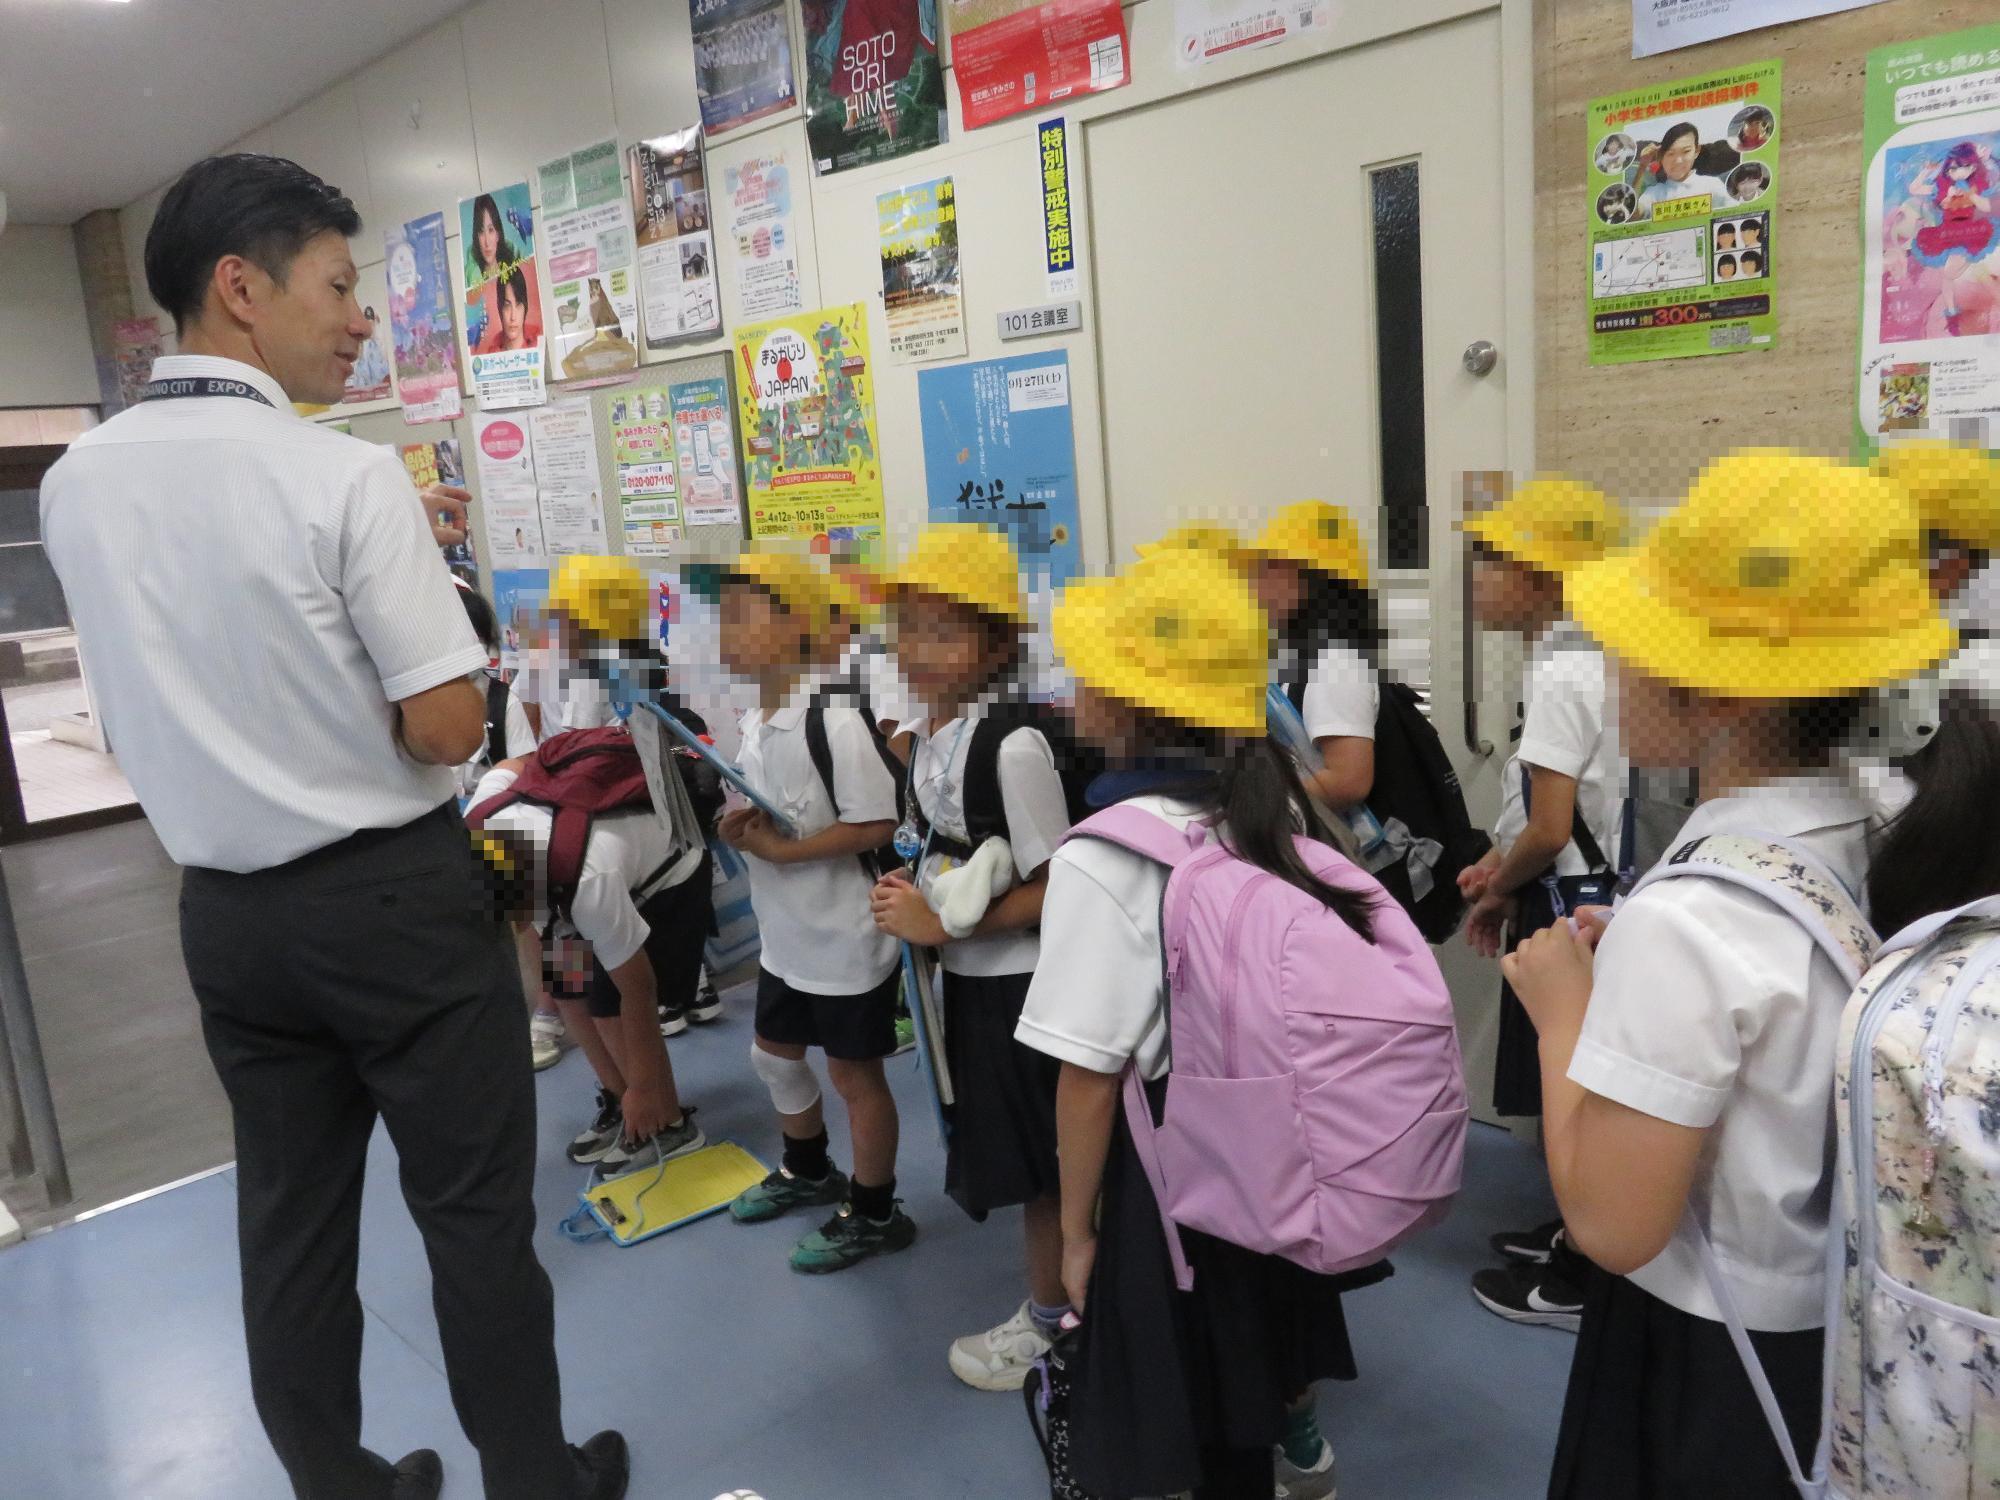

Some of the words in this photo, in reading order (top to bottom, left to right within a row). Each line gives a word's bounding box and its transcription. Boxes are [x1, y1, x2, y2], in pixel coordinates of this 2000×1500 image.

[842, 30, 896, 71] SOTO
[851, 59, 887, 93] ORI
[843, 82, 898, 123] HIME
[1041, 127, 1071, 269] 特別警戒実施中
[1004, 307, 1069, 332] 101会議室
[761, 342, 806, 366] まるかじり
[170, 380, 196, 394] CITY
[208, 380, 247, 395] EXPO
[765, 375, 809, 398] JAPAN
